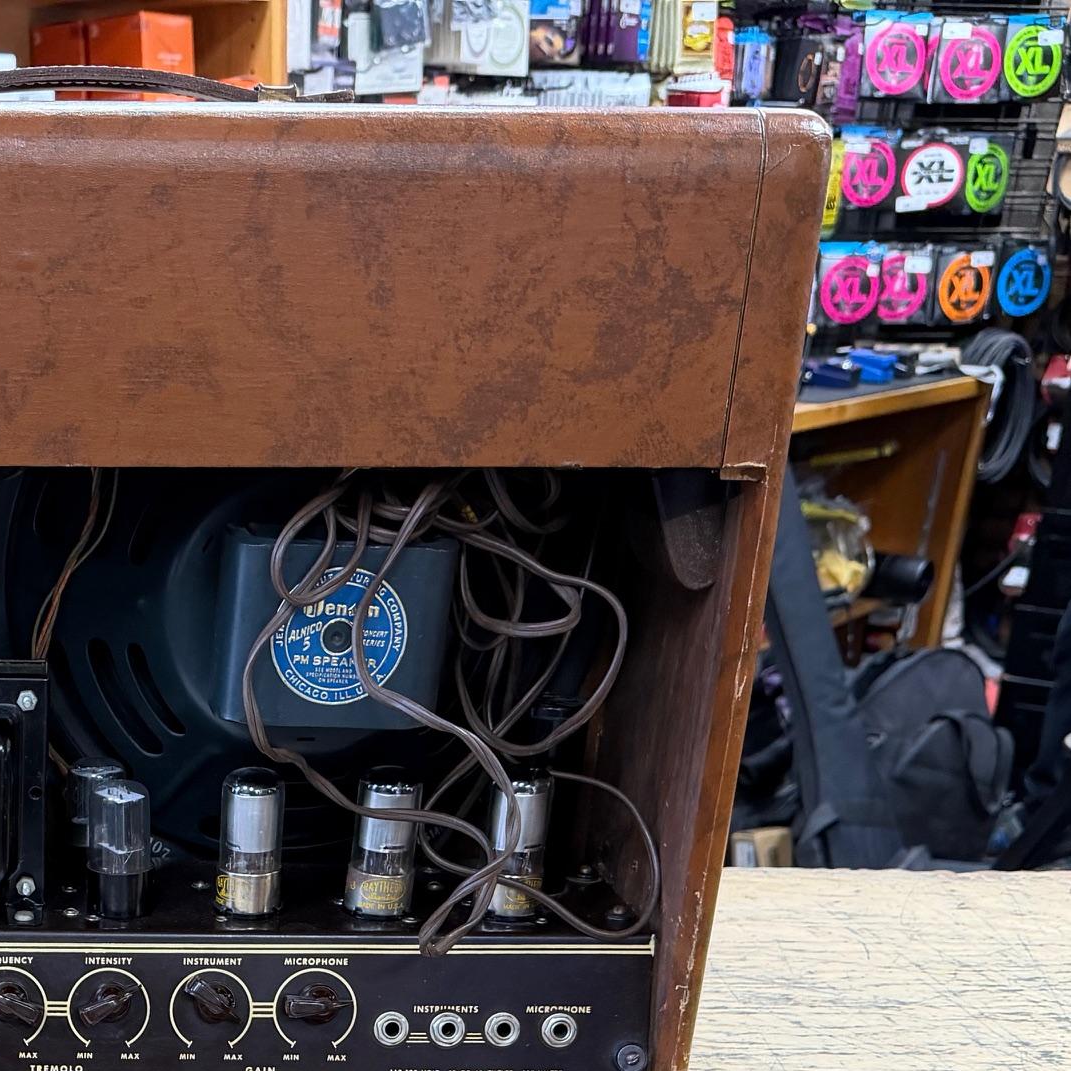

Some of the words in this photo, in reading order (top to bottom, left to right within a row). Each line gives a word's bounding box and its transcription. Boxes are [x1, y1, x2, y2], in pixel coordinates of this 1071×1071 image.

[877, 44, 915, 73] XL
[953, 48, 990, 78] XL
[1015, 46, 1050, 75] XL
[851, 159, 885, 187] XL
[912, 160, 954, 184] XL
[972, 163, 999, 191] XL
[832, 277, 867, 303] XL
[949, 273, 980, 302] XL
[1007, 270, 1040, 295] XL
[288, 621, 324, 644] ALNICO
[386, 597, 403, 652] COMPANY
[302, 636, 311, 652] 5
[293, 654, 309, 666] PM
[313, 655, 377, 669] SPEAR
[84, 956, 133, 966] INTENSITY
[182, 957, 243, 966] INSTRUMENT
[283, 957, 349, 966] MICROPHONE
[526, 1005, 592, 1014] MICROPHONE
[18, 1051, 38, 1059] MAX
[76, 1052, 93, 1060] MIN
[120, 1052, 140, 1060] MAX
[223, 1053, 243, 1061] MAX
[282, 1053, 300, 1061] MIN
[326, 1054, 347, 1062] MAX
